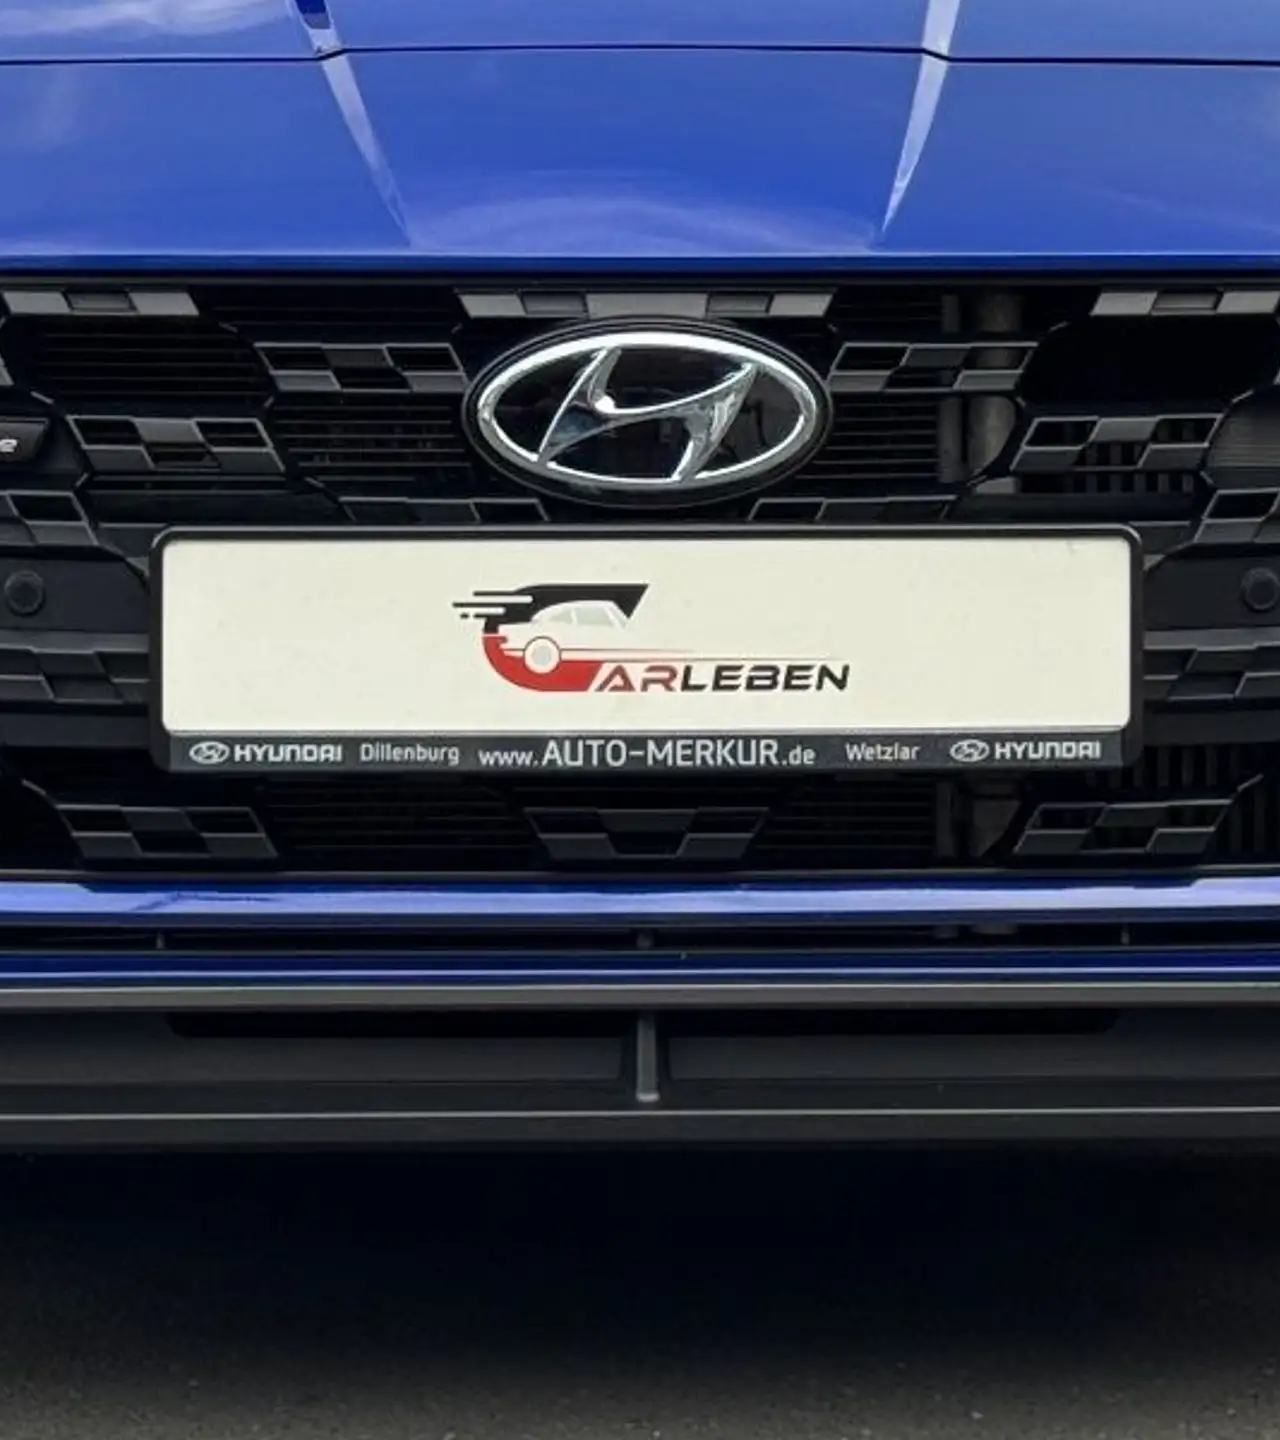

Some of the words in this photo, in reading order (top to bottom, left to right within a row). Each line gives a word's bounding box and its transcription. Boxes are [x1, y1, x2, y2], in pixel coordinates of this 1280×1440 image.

[233, 743, 343, 763] HYUNDAI
[359, 743, 460, 767] Dillenburg
[477, 738, 817, 769] www.AUTO-MERKUR.de
[845, 742, 921, 762] Wetzlar
[994, 740, 1102, 761] HYUNDAI
